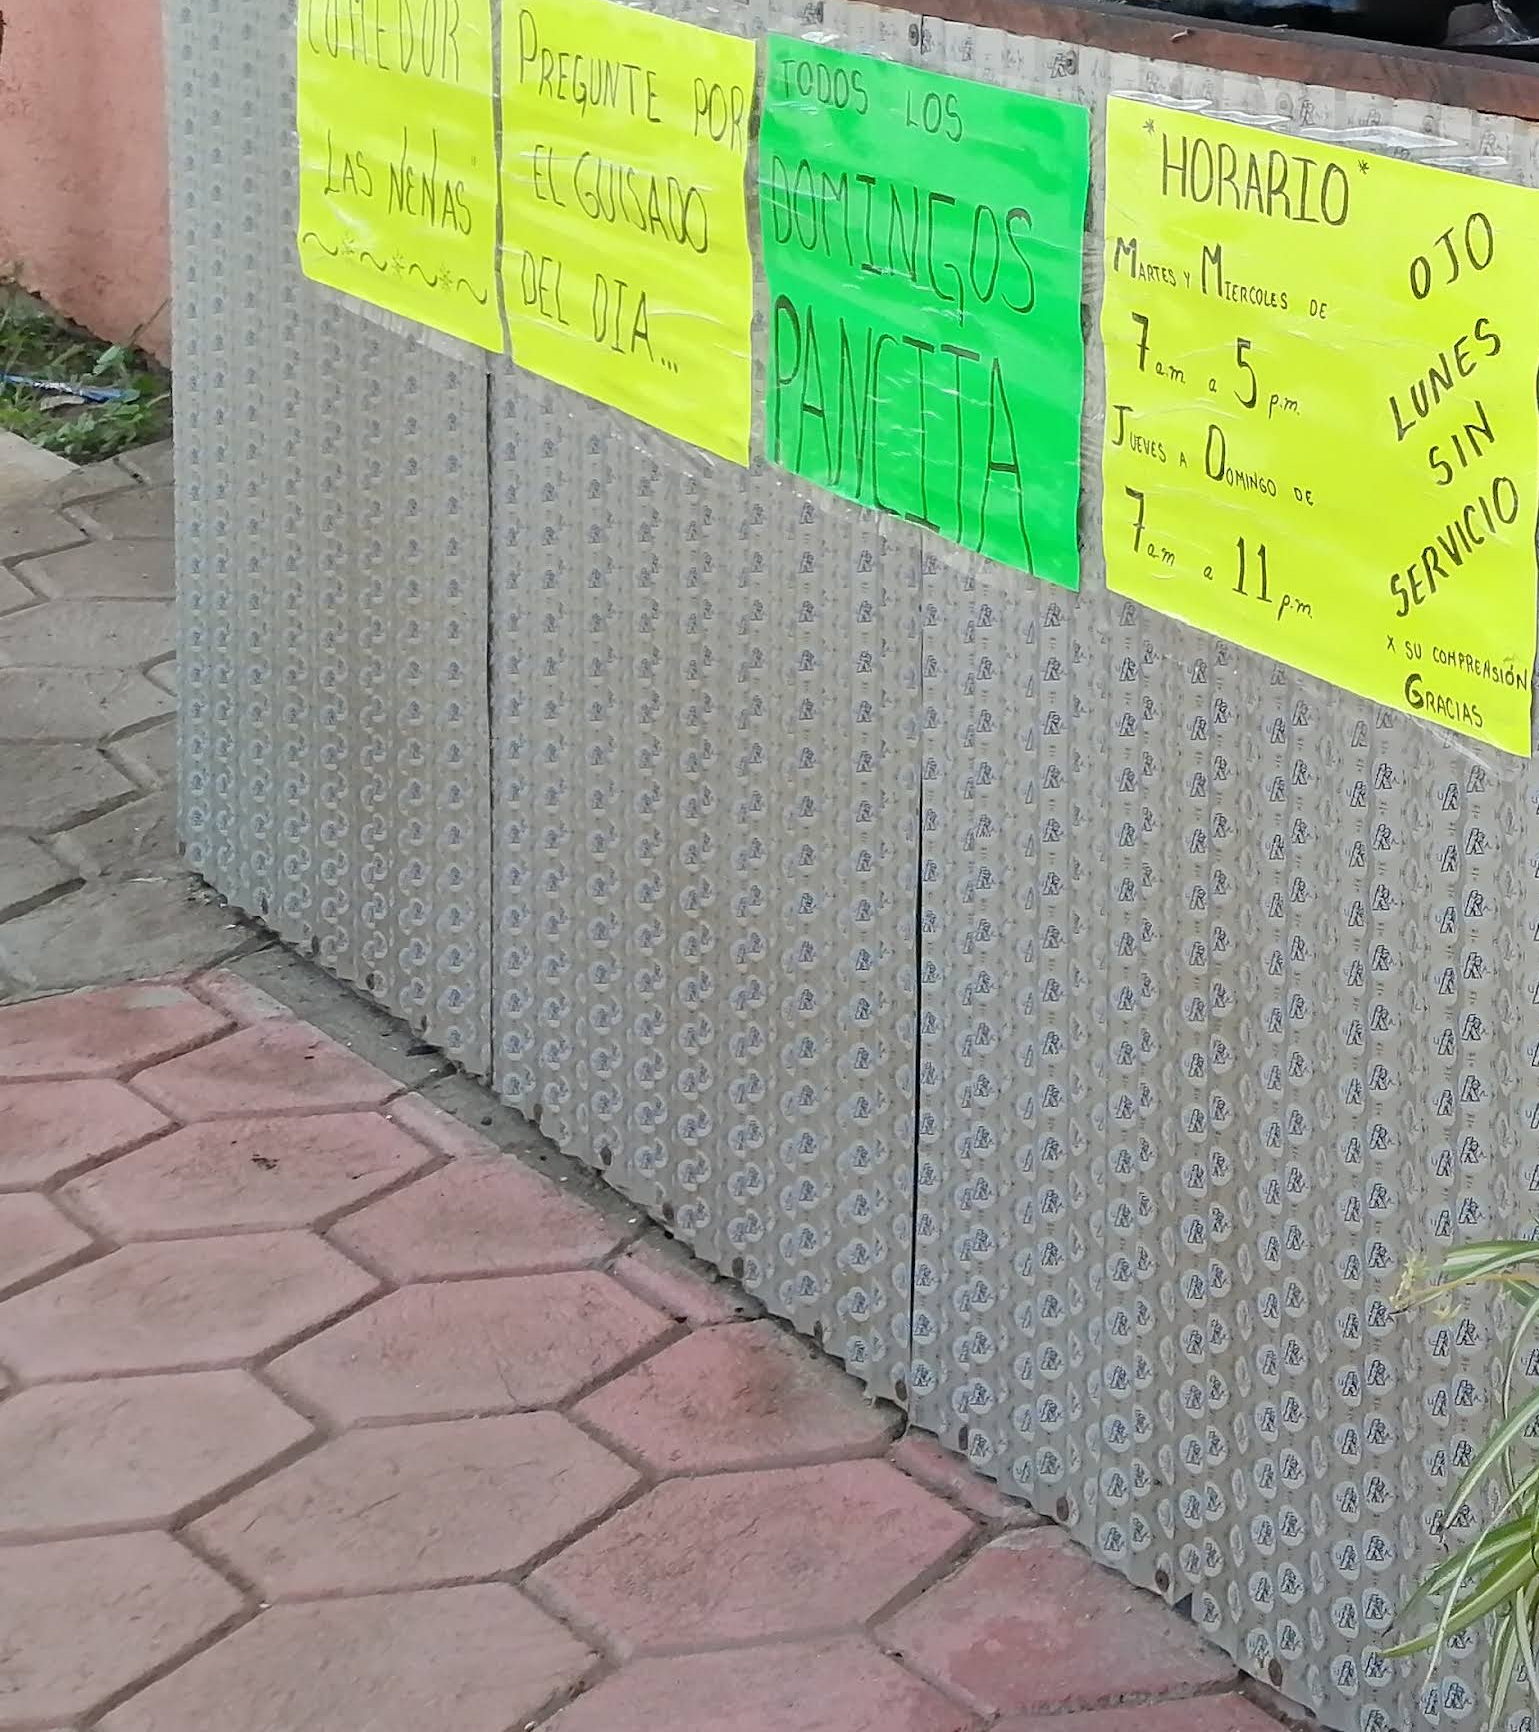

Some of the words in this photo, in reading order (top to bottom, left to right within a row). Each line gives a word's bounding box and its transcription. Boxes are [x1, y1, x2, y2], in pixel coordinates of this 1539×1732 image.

[518, 9, 660, 124] PREGUNTE
[694, 77, 744, 152] POR
[780, 59, 868, 116] TODOS
[906, 89, 963, 142] LOS
[324, 129, 374, 198] LAS
[534, 144, 567, 207] EL
[573, 151, 708, 254] GUISADO
[1162, 132, 1349, 226] HORARIO
[521, 249, 570, 326] DEL
[771, 154, 1037, 328] DOMINGOS
[1113, 236, 1177, 286] MARTES
[1183, 270, 1191, 289] Y
[1200, 242, 1289, 310] MIERCOLES
[1309, 298, 1328, 319] DE
[1409, 211, 1494, 300] OJO
[1131, 311, 1150, 372] 7
[1208, 378, 1217, 394] a
[1233, 336, 1258, 409] 5
[1388, 317, 1501, 442] LUNES
[773, 293, 1035, 576] PANCITA
[1111, 404, 1167, 464] JUEVES
[1179, 450, 1188, 468] A
[1204, 424, 1277, 498] DOMINGO
[1293, 486, 1314, 507] DE
[1428, 399, 1496, 486] SIN
[1125, 485, 1146, 553] 7
[1202, 565, 1214, 581] a
[1231, 535, 1273, 603] 11
[1389, 475, 1519, 618] SERVICIO
[1403, 672, 1484, 728] GRACIAS
[1404, 640, 1422, 660] SU
[1432, 645, 1528, 691] COMPRENSIÓN
